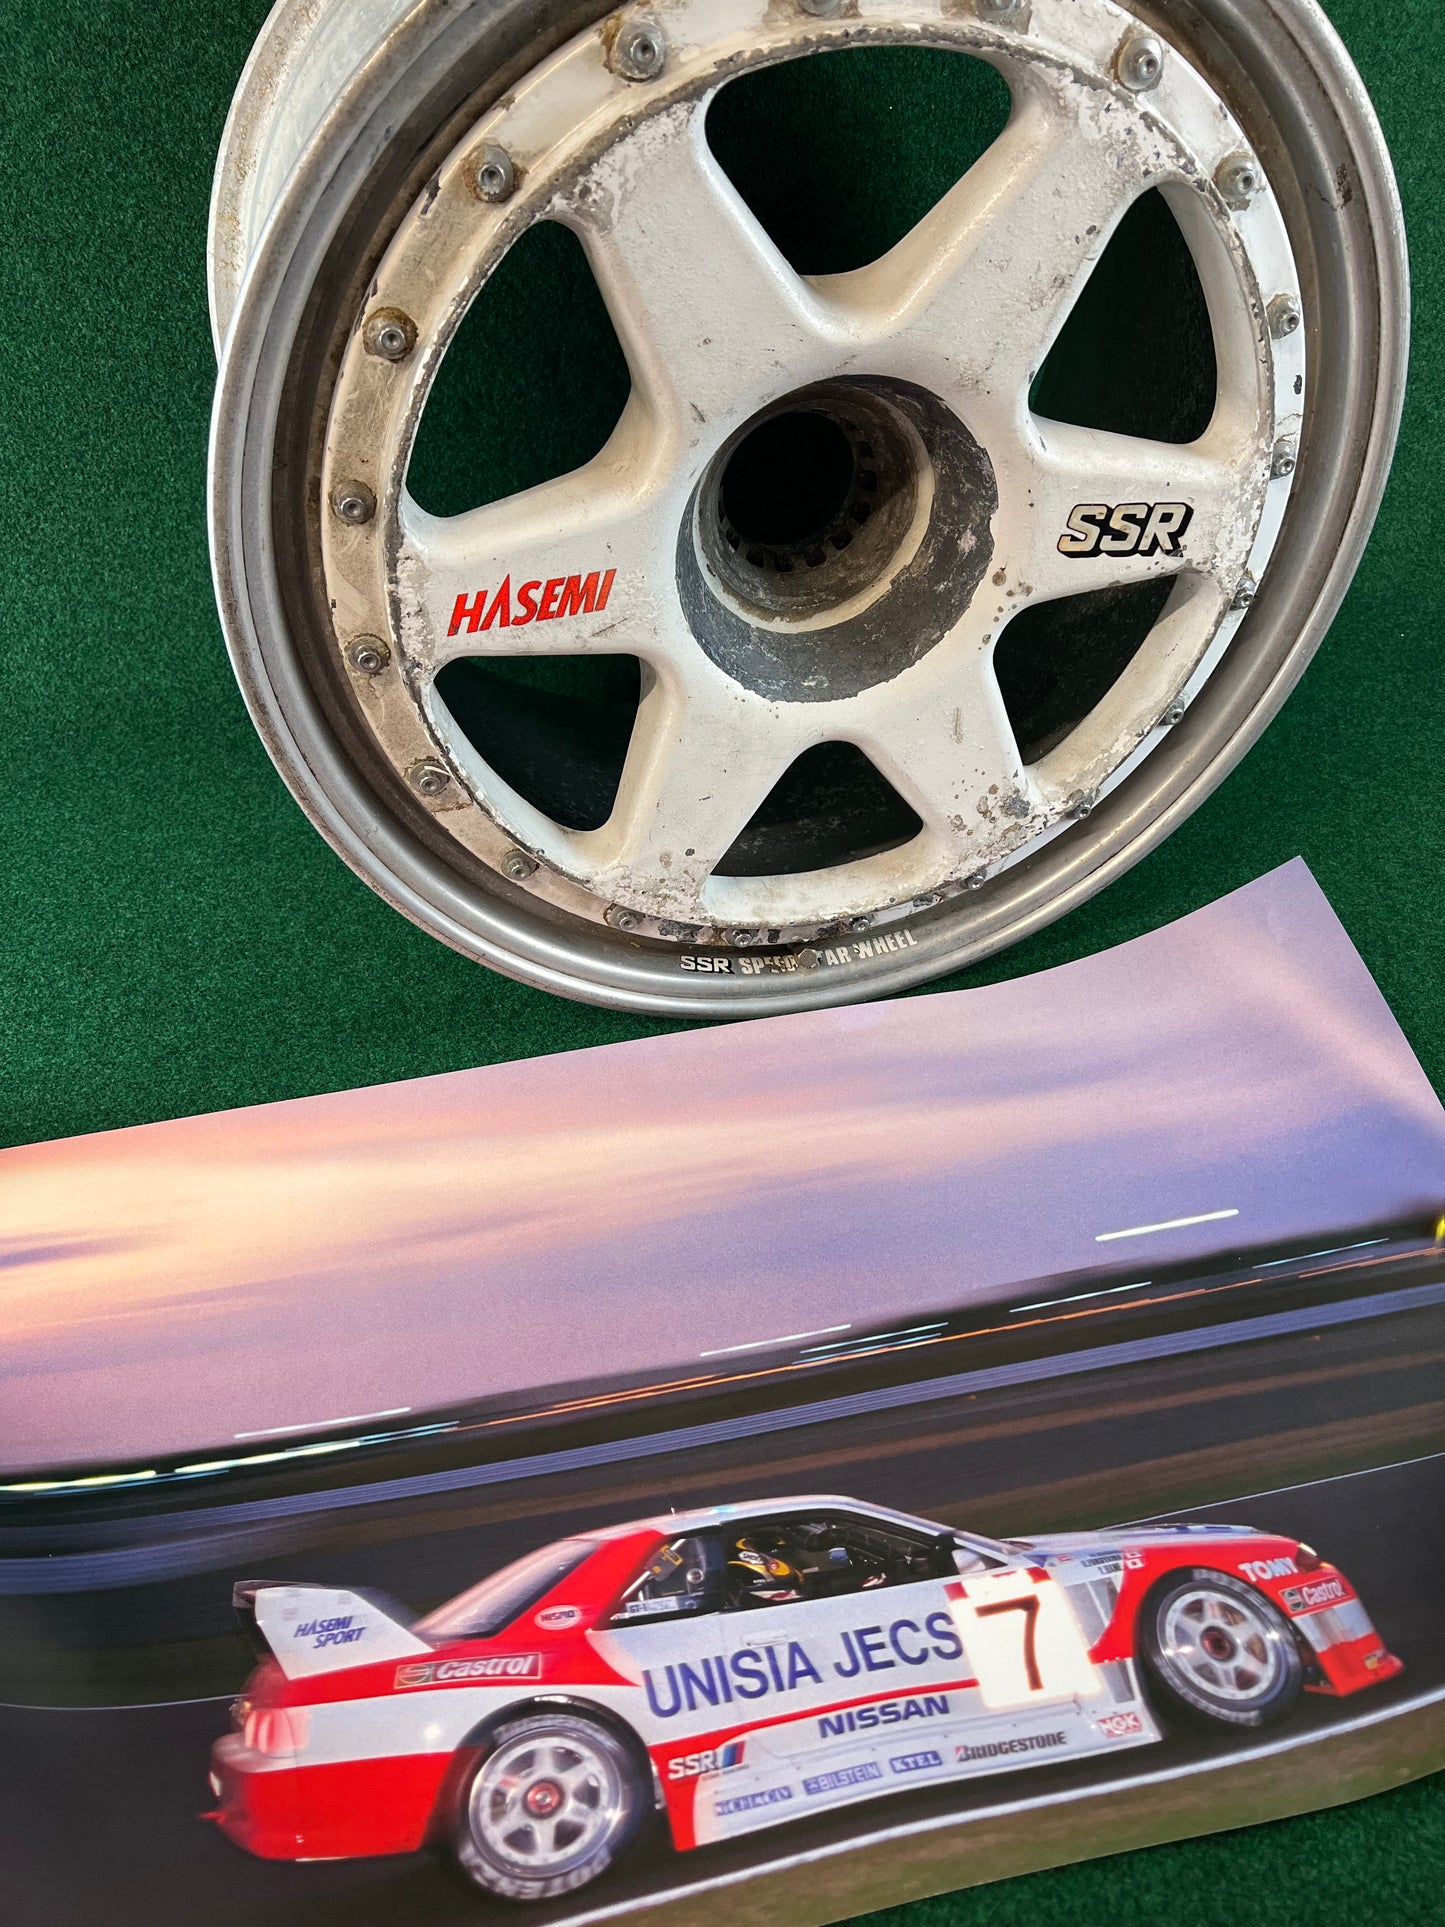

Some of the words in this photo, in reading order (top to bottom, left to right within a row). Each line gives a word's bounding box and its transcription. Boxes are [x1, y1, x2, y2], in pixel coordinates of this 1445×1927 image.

[1057, 502, 1194, 558] SSR
[447, 568, 617, 637] HASEMI
[679, 955, 735, 974] SSR
[852, 928, 918, 959] WHEEL
[1238, 1557, 1298, 1582] TOMY
[1302, 1579, 1345, 1605] Castrol
[293, 1615, 353, 1638] HASEMI
[312, 1626, 366, 1649] SPORT
[974, 1594, 1044, 1691] 7
[436, 1655, 535, 1680] Castrol
[642, 1641, 823, 1718] UNISIA
[834, 1611, 964, 1678] JECS
[818, 1695, 950, 1738] NISSAN
[1098, 1712, 1142, 1736] NGK
[955, 1731, 1067, 1762] BRIDGESTONE
[668, 1750, 720, 1780] SSR
[818, 1764, 881, 1790] BILSTEIN
